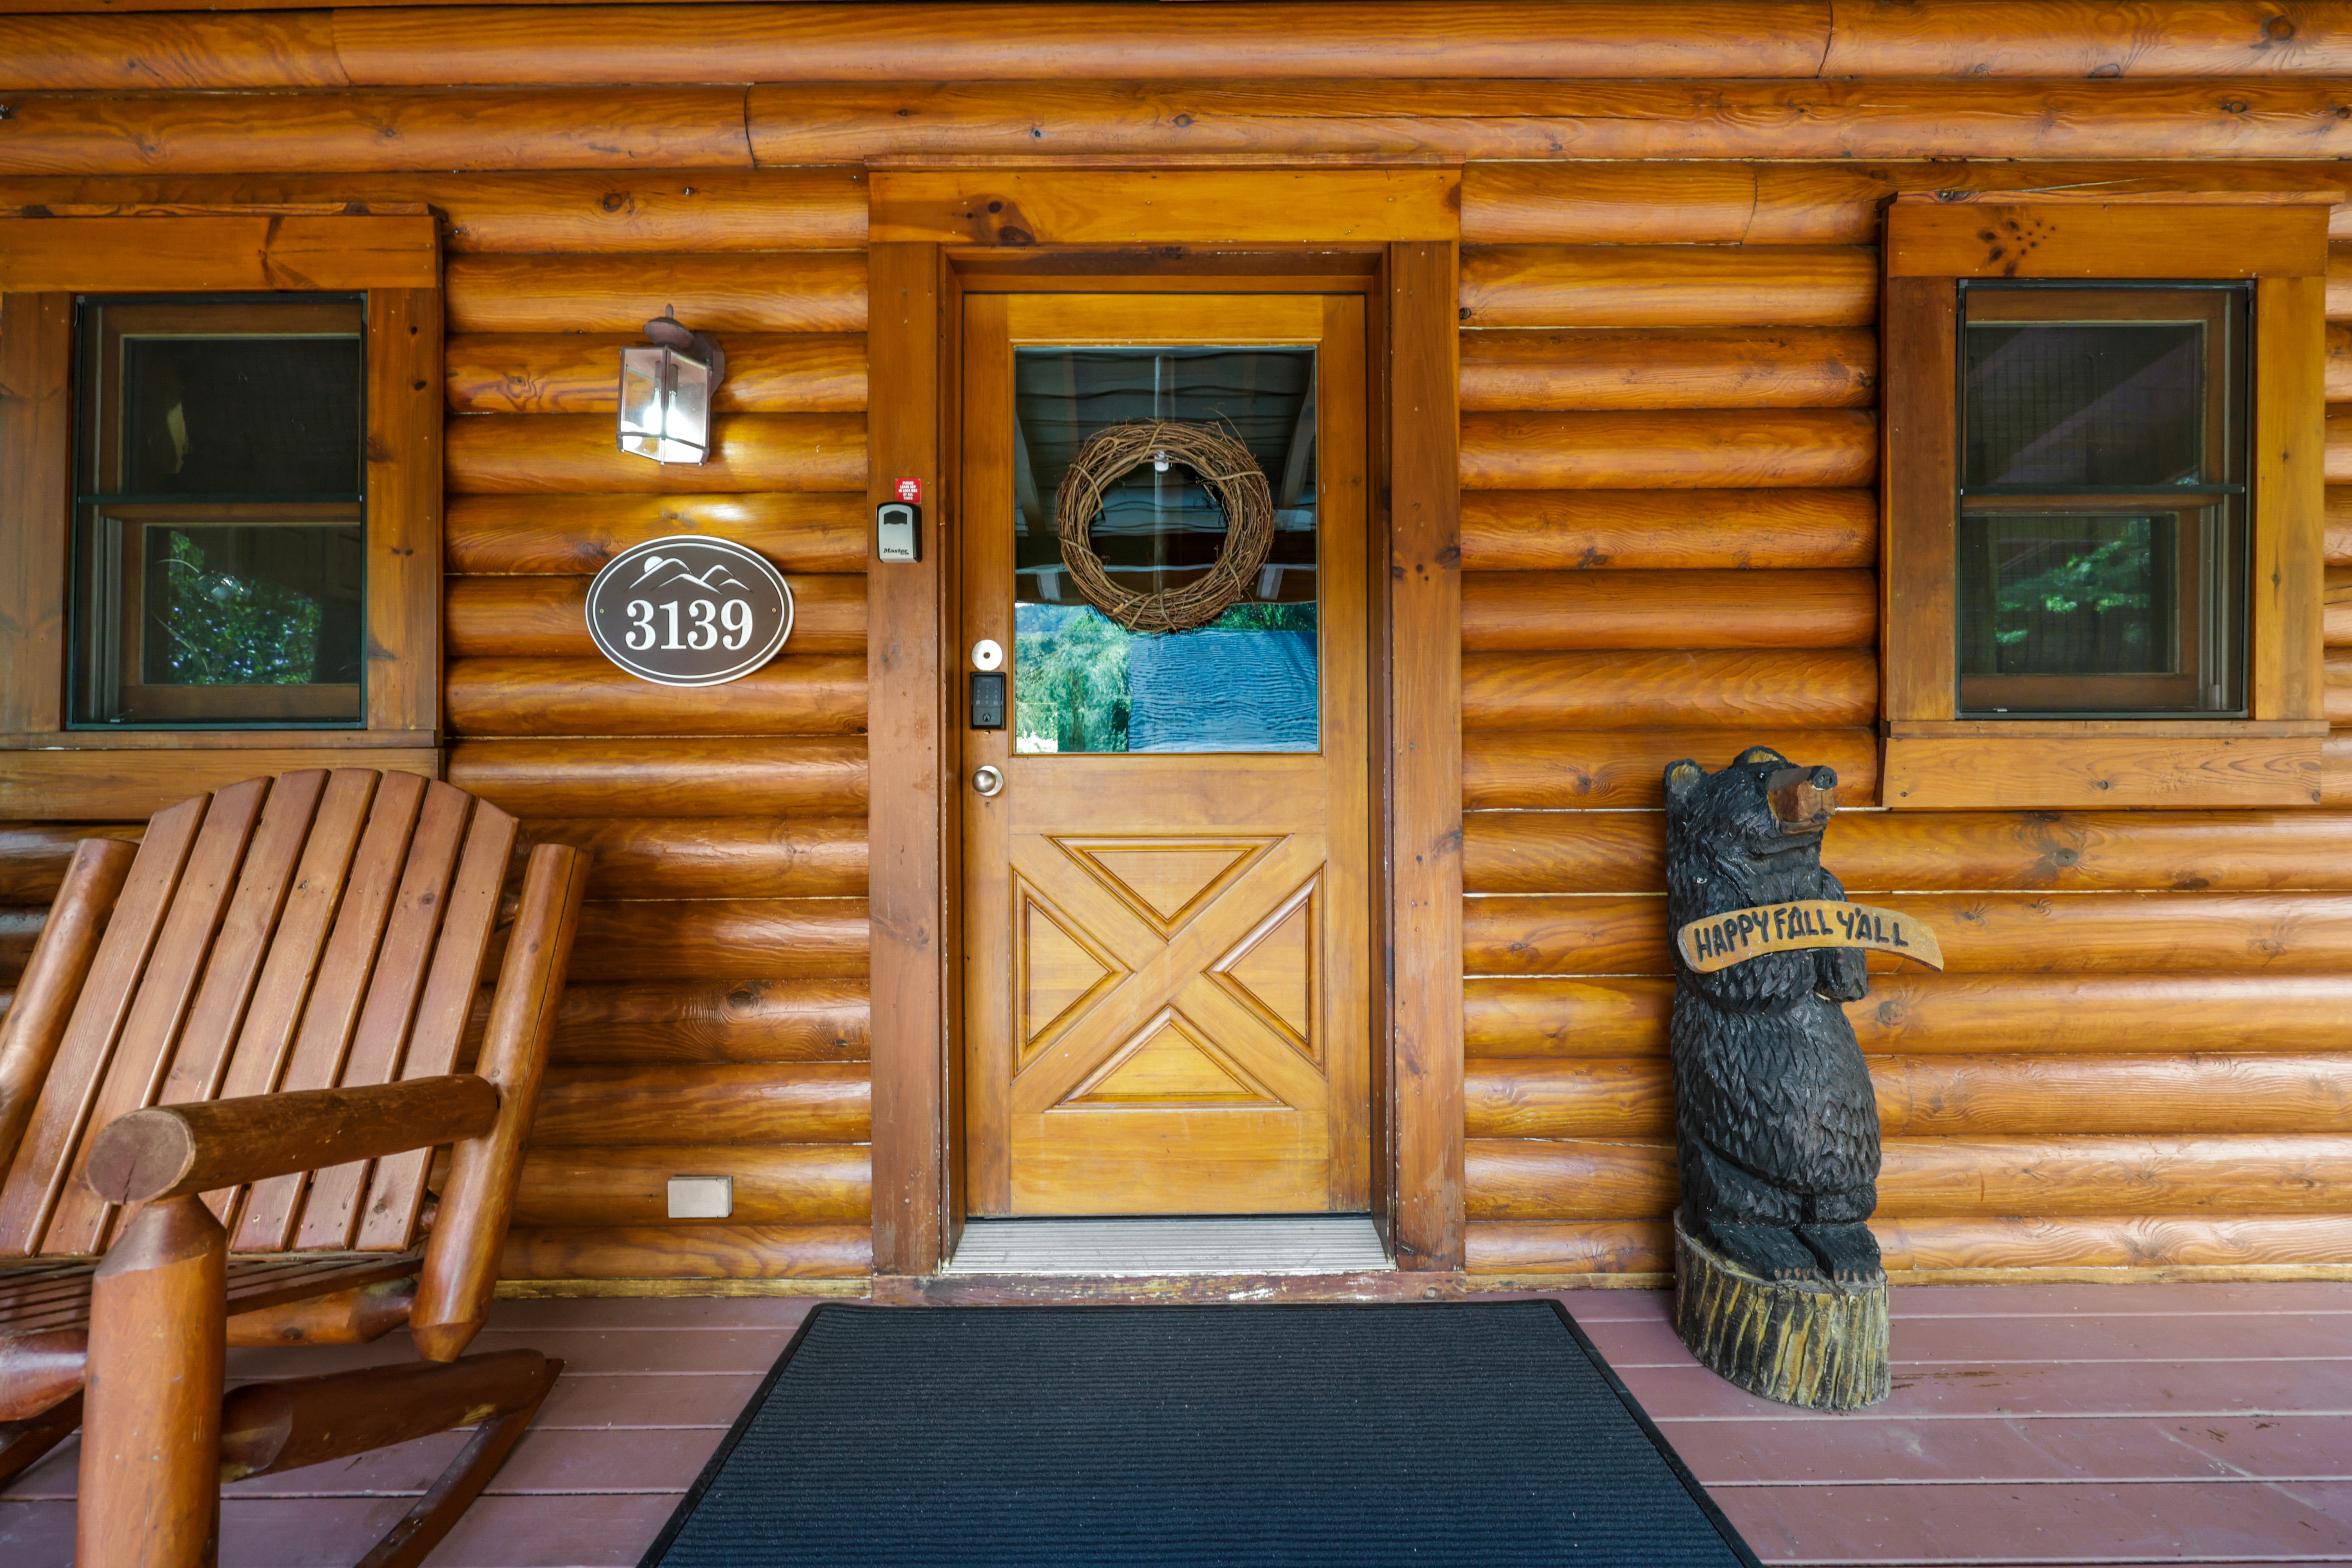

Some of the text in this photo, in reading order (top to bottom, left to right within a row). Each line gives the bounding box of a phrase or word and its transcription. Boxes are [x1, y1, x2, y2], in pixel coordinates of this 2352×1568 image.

[625, 599, 753, 650] 3139
[1694, 906, 1909, 962] HAPPY FALL Y'ALL
